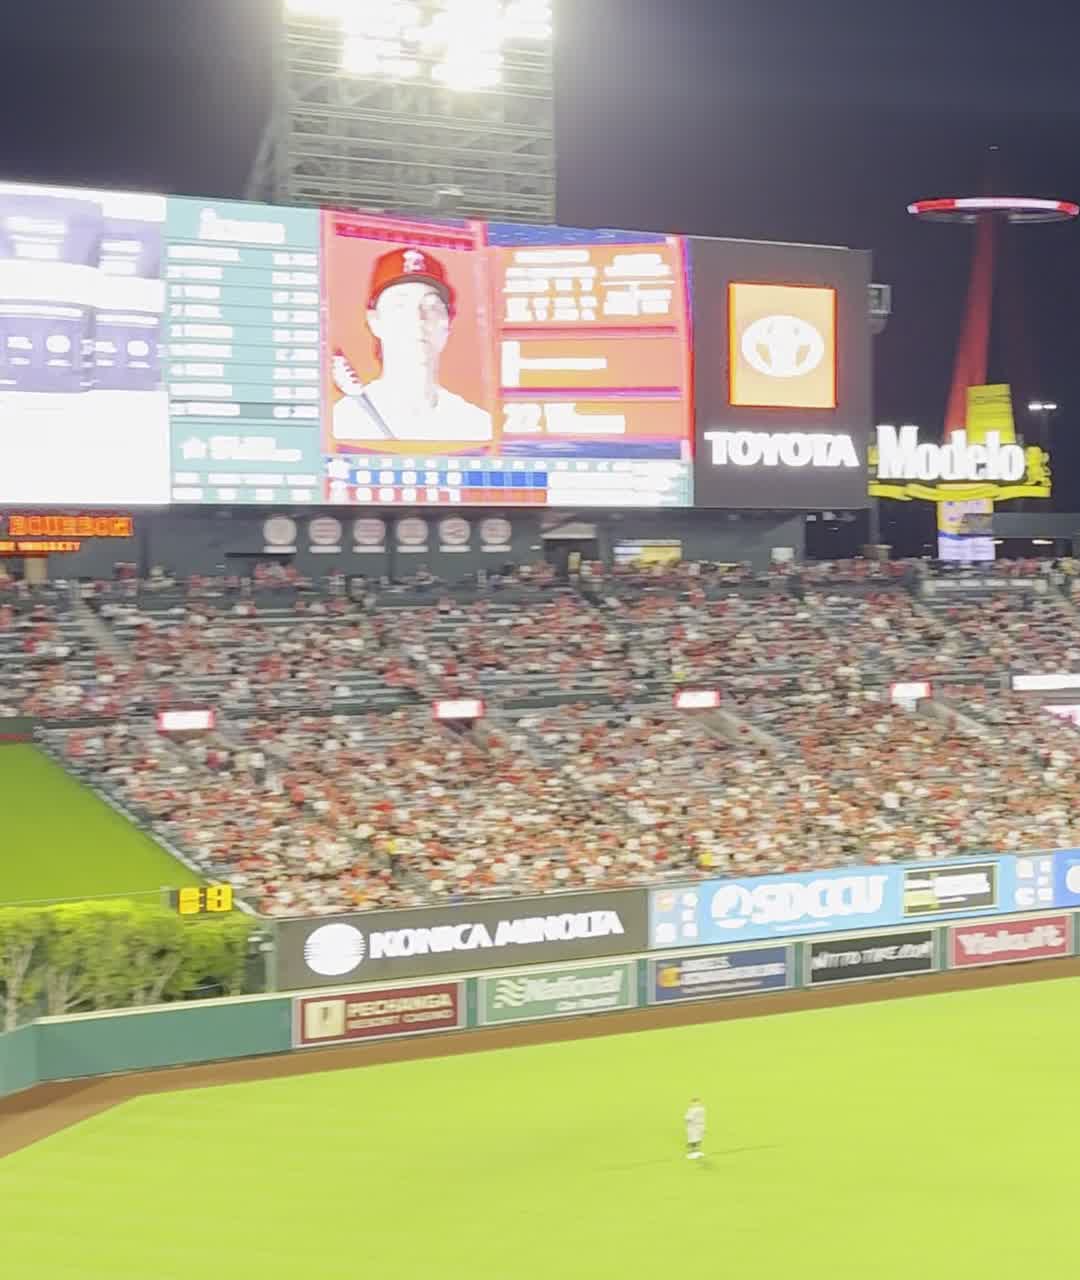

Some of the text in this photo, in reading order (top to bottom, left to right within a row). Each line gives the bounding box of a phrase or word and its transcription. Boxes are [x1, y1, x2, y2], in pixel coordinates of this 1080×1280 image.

[704, 431, 860, 467] TOYOTA
[876, 425, 1025, 480] Modelo
[369, 910, 625, 959] KONICA MINOLTA
[957, 924, 1065, 956] Yakult
[524, 969, 624, 1002] National
